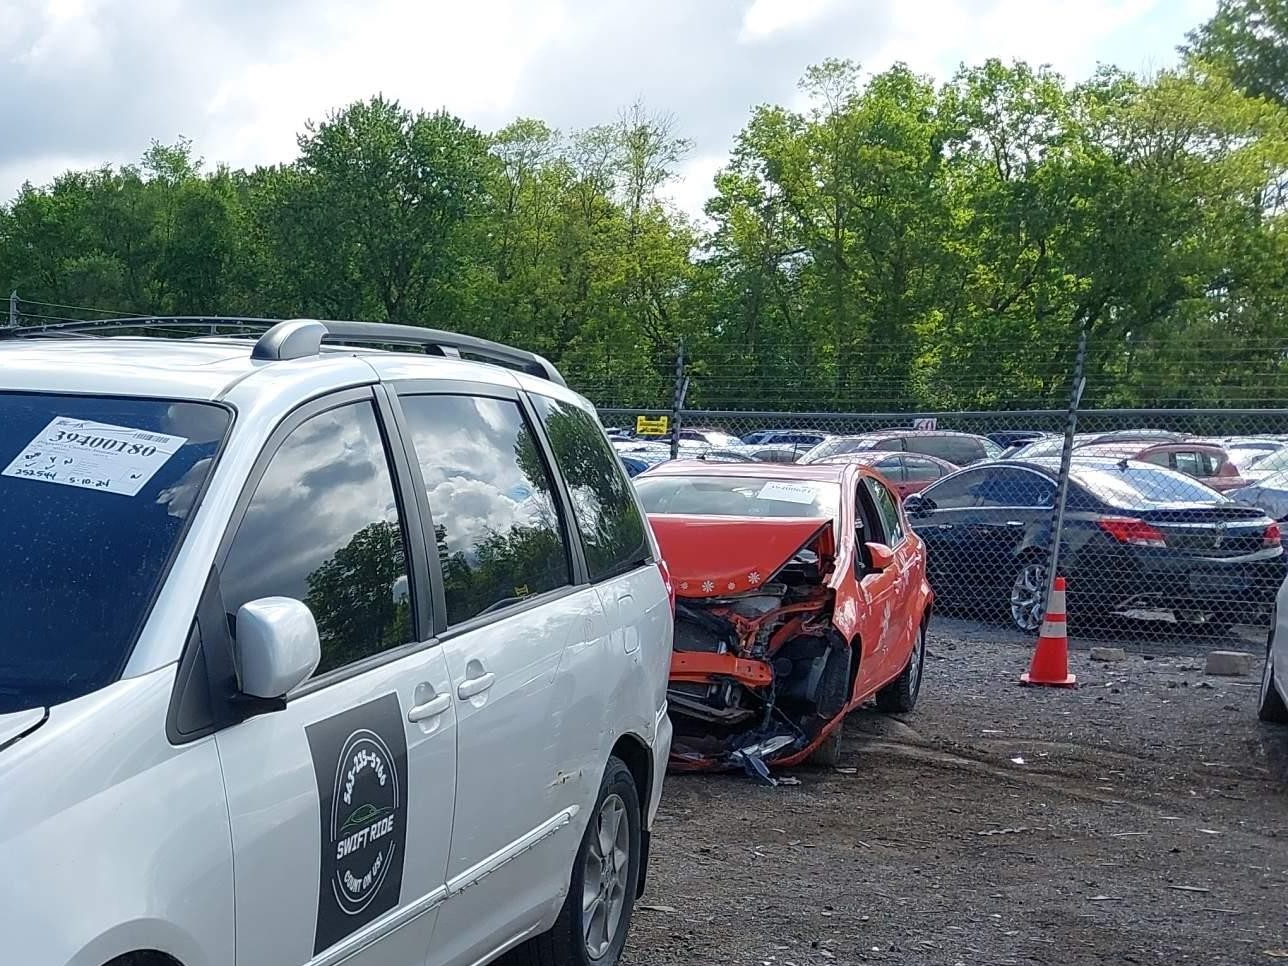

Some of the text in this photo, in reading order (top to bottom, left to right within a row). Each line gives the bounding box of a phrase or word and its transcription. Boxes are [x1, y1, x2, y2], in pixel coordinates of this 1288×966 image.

[49, 430, 157, 457] 39400180
[336, 814, 394, 860] SWIFT RIDE
[344, 869, 362, 893] COUNT
[362, 870, 372, 890] ON
